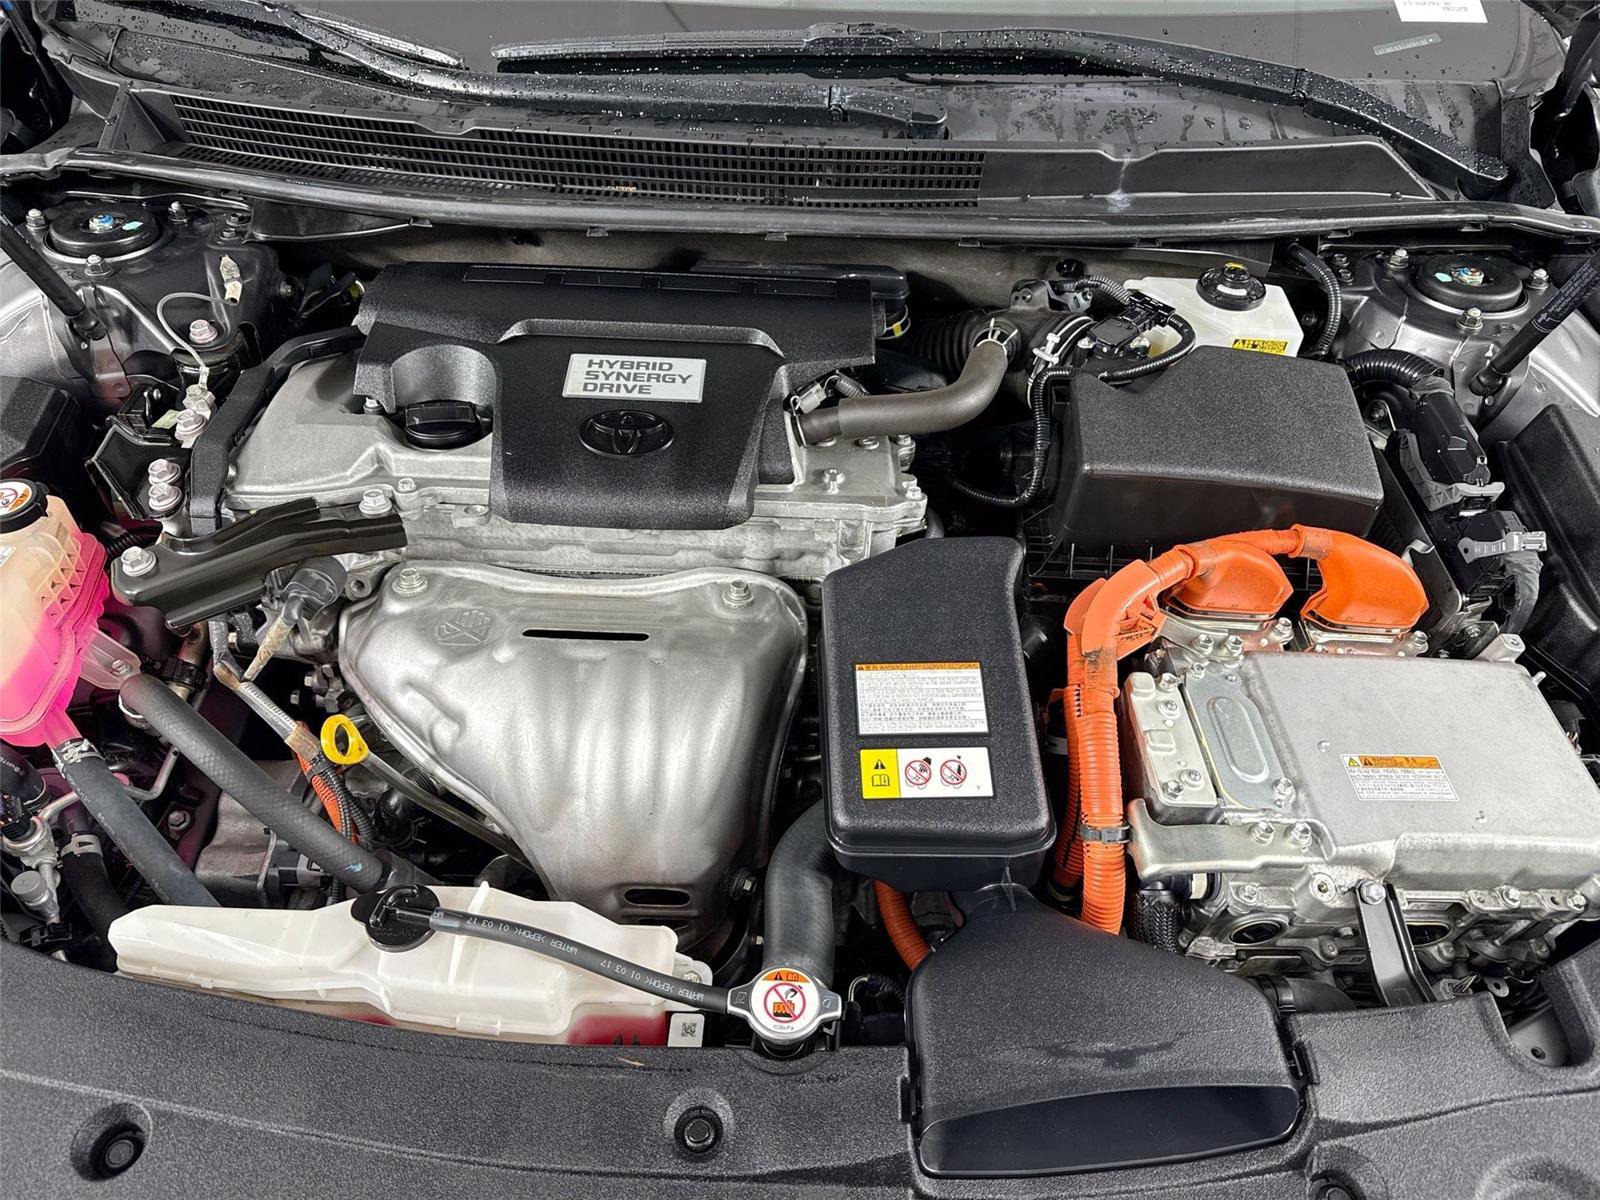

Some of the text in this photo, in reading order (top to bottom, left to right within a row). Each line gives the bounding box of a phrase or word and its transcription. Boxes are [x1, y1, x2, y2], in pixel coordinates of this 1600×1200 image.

[588, 359, 673, 371] HYBRID
[585, 370, 692, 384] SYNERGY
[583, 382, 653, 395] DRIVE
[466, 916, 478, 926] 17
[481, 919, 494, 929] 03
[499, 923, 510, 933] 01
[550, 938, 578, 955] WATER
[600, 959, 611, 969] 17
[615, 964, 627, 975] 03
[630, 970, 641, 981] 01
[677, 988, 705, 1002] WATER
